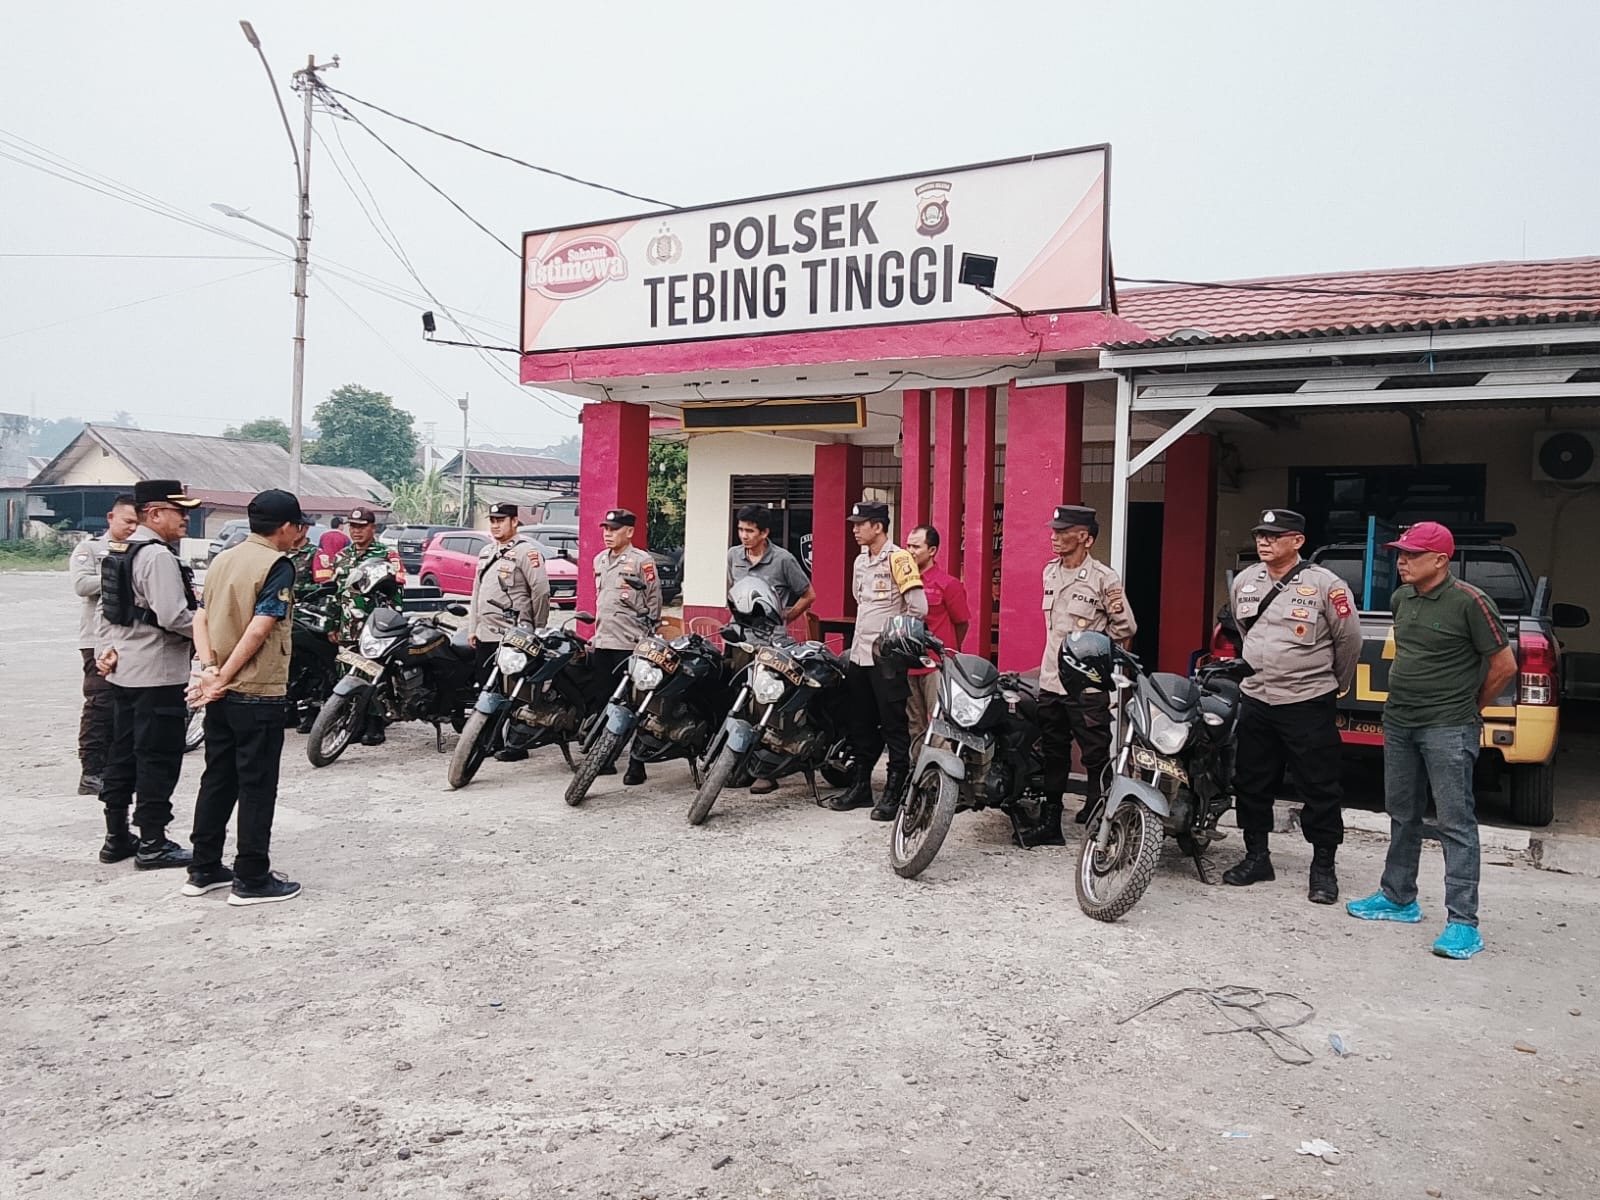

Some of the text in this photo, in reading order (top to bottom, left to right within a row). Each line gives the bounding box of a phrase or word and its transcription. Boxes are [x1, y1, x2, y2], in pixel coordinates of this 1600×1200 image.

[709, 200, 879, 263] POLSEK
[567, 245, 607, 262] Sahabat
[529, 256, 624, 285] Istimewa
[643, 244, 953, 328] TEBING TINGGI
[1291, 598, 1317, 607] POLRI
